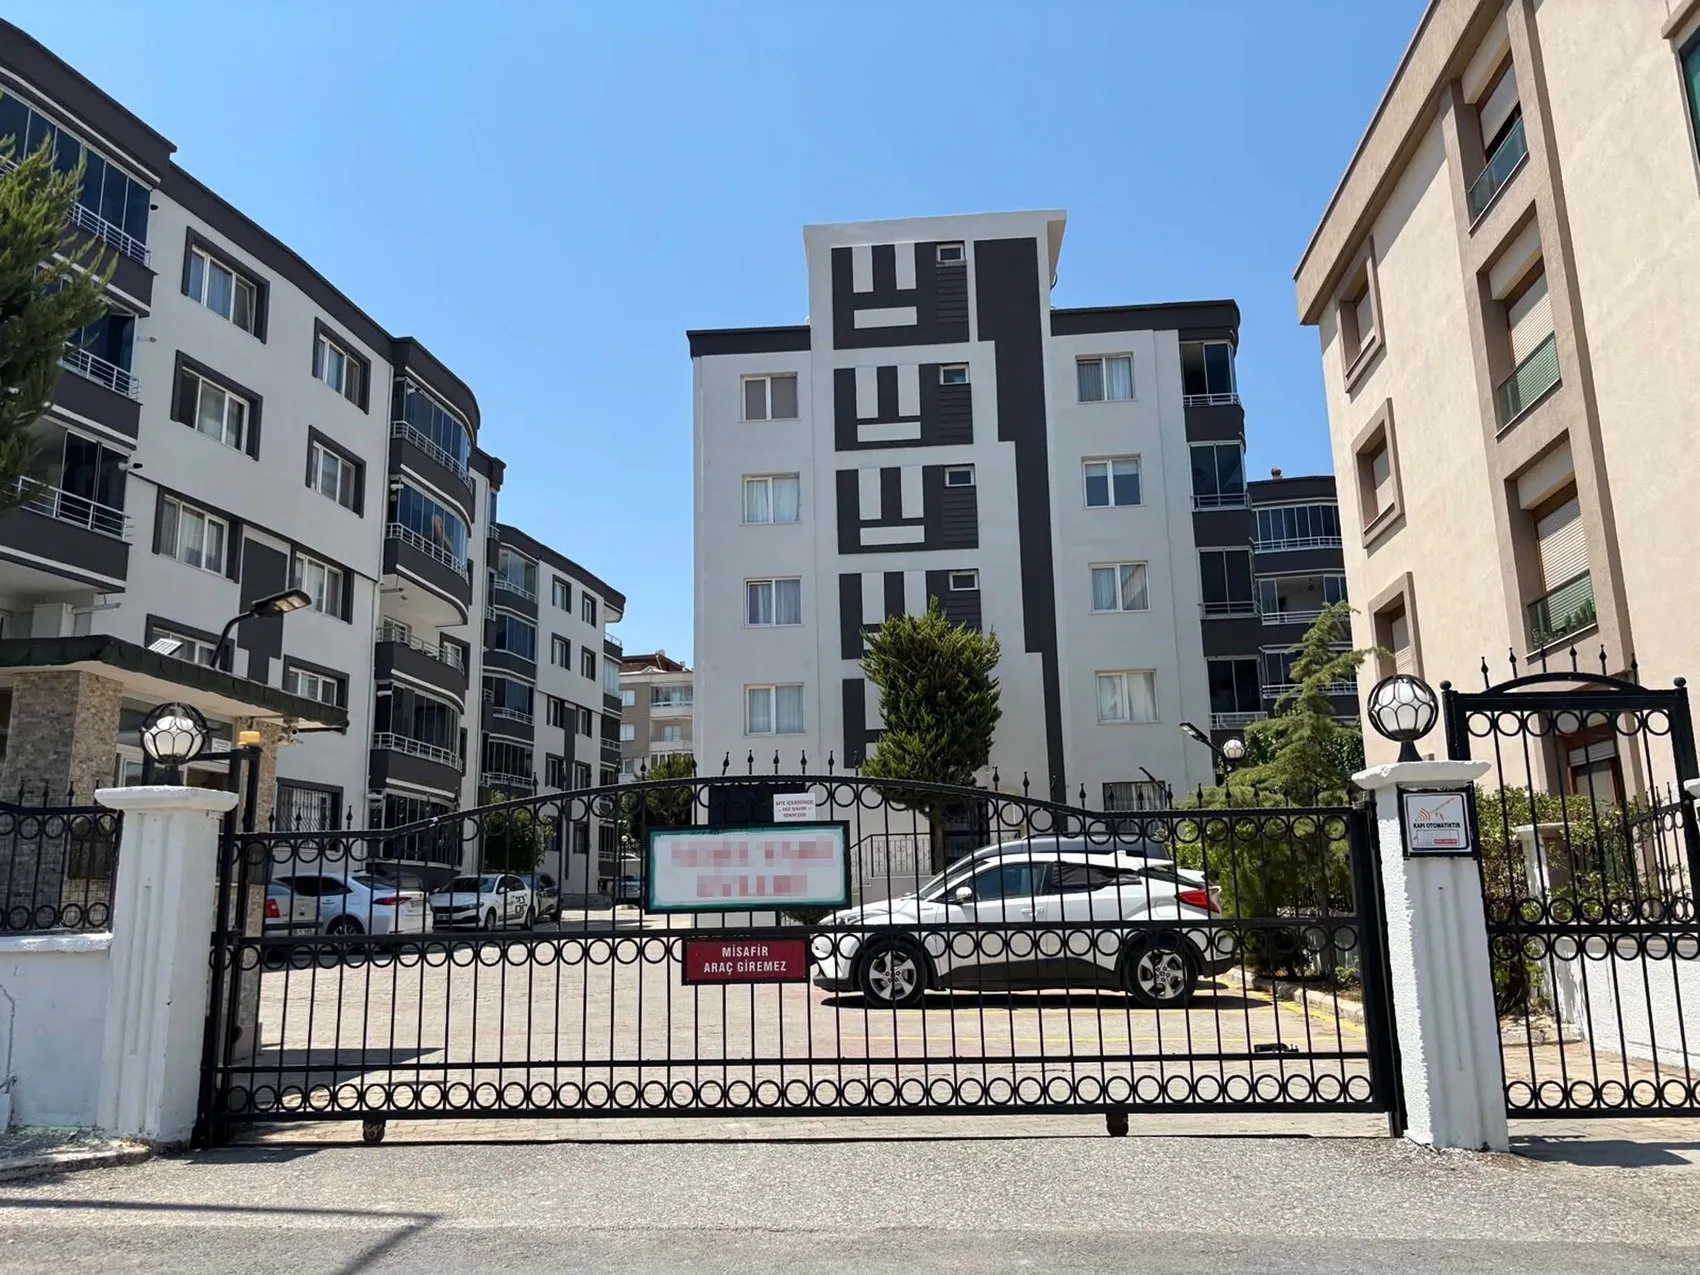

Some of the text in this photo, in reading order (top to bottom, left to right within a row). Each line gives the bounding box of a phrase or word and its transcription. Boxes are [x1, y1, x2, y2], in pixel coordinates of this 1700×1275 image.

[722, 943, 769, 957] MİSAFİR
[703, 959, 787, 976] ARAÇ GİREMEZ
